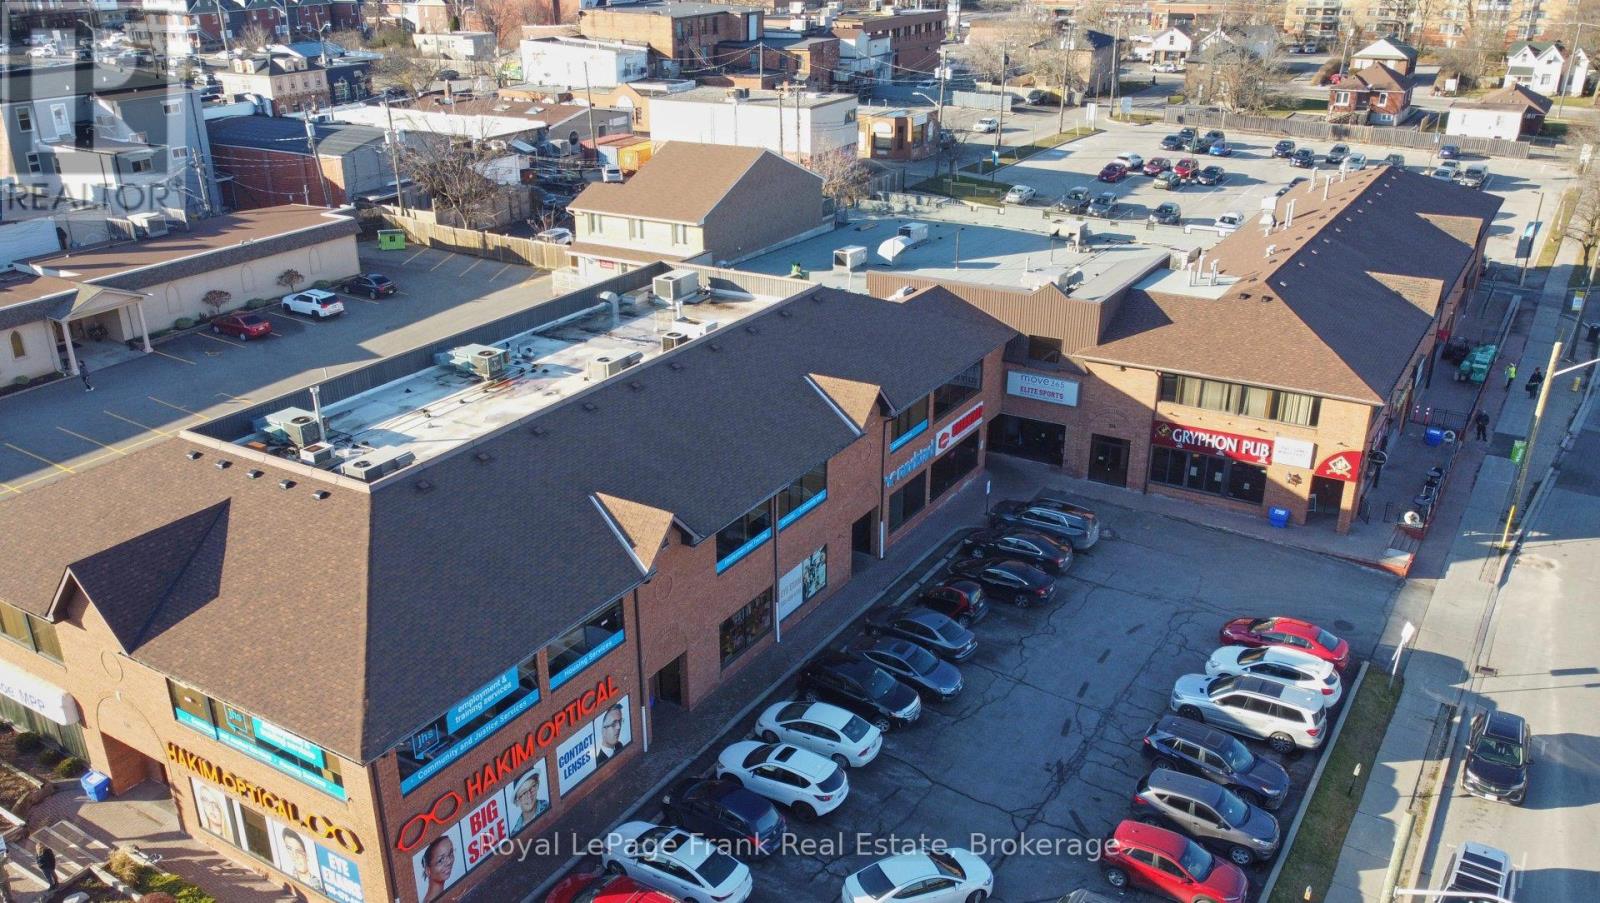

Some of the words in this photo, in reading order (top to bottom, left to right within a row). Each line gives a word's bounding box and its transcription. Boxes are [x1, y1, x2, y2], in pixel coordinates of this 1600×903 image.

[1020, 386, 1037, 395] ELITE
[1039, 389, 1064, 400] SPORTS
[1172, 428, 1238, 453] GRYPHON
[1241, 442, 1270, 458] PUB
[455, 702, 483, 724] training
[484, 682, 512, 705] services
[457, 678, 501, 713] employment
[417, 745, 458, 780] Community
[460, 737, 473, 750] and
[474, 720, 498, 742] Justice
[500, 700, 528, 723] Services
[465, 734, 535, 803] HAKIM
[536, 675, 619, 748] OPTICAL
[558, 734, 594, 769] CONTACT
[168, 742, 221, 785] HAKIM
[223, 773, 301, 823] OPTICAL
[564, 751, 592, 780] LENSES
[469, 799, 499, 838] BIG
[467, 819, 507, 865] SALE
